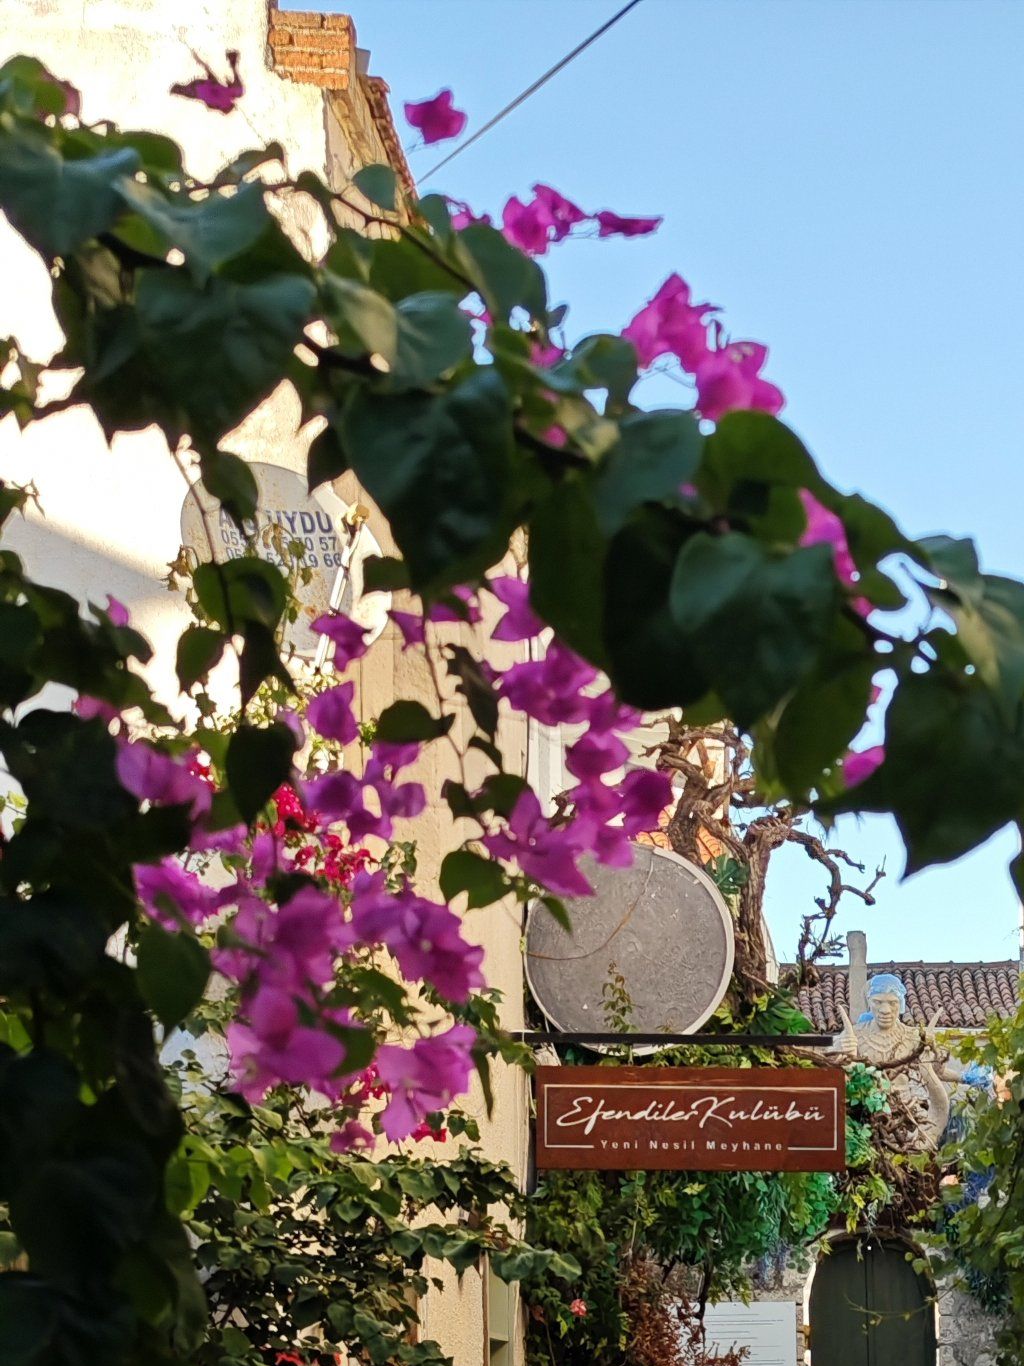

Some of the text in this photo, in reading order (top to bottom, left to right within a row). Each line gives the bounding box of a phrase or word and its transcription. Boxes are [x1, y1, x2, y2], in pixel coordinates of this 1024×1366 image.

[319, 537, 336, 551] 57
[556, 1096, 825, 1135] Efendiler Kulübü
[600, 1139, 783, 1153] Yeni Nesil Meyhane
